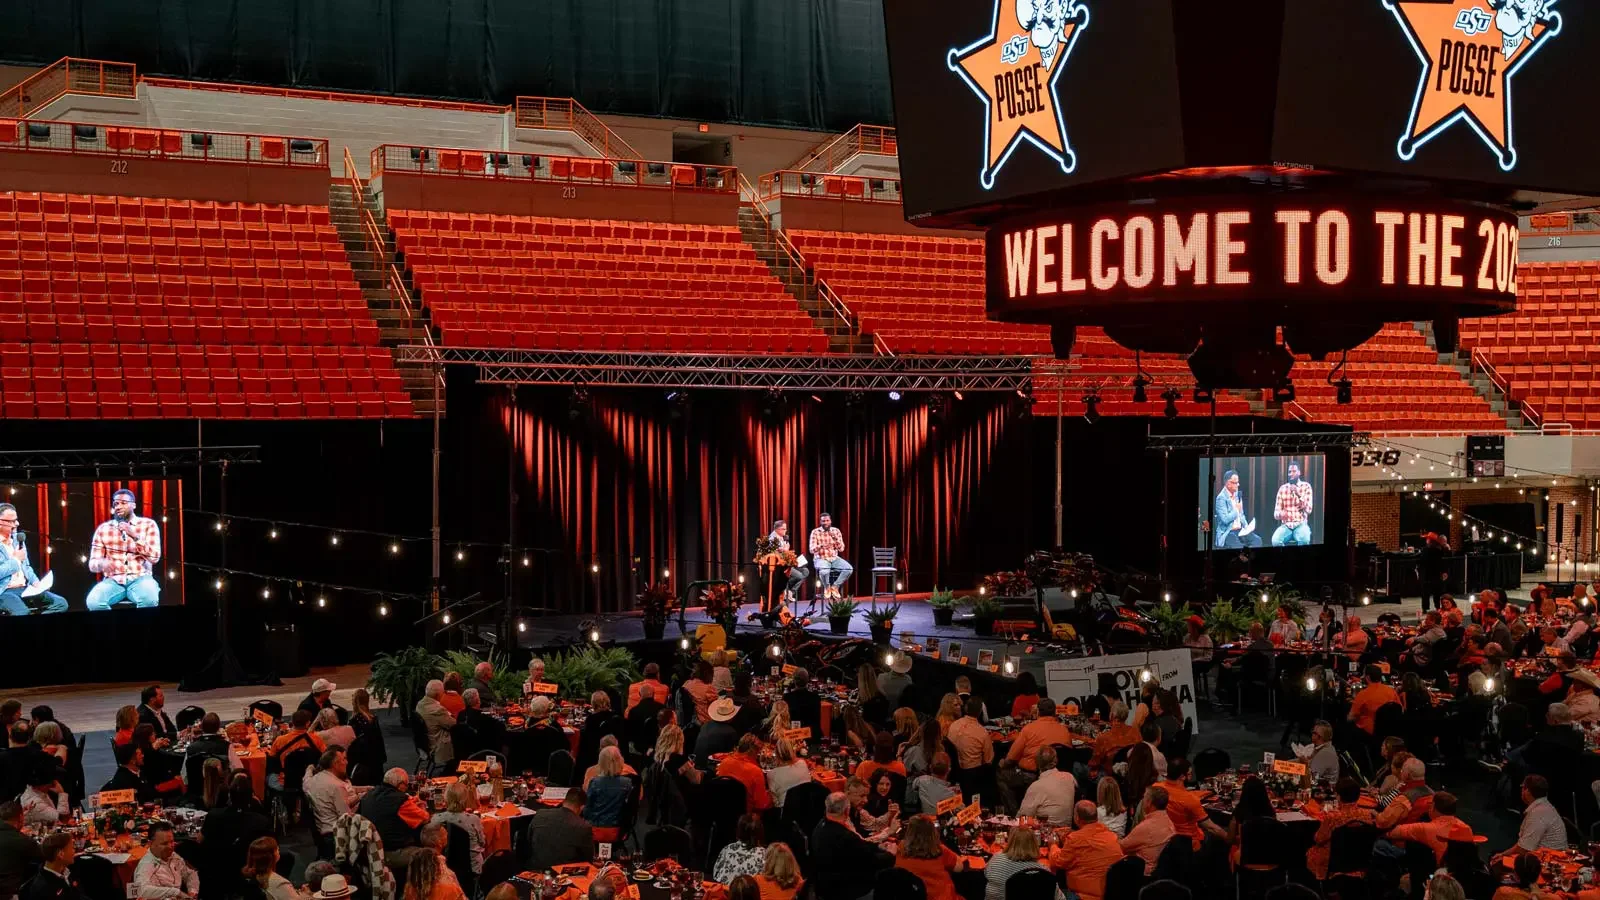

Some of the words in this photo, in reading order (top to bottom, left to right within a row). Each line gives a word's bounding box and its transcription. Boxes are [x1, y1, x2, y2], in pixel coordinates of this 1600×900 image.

[1455, 7, 1493, 35] OSU
[1001, 35, 1029, 63] OSU
[1436, 38, 1500, 98] POSSE
[994, 62, 1045, 122] POSSE
[111, 160, 128, 173] 212
[562, 186, 576, 198] 213
[1548, 236, 1561, 246] 216
[1004, 211, 1250, 298] WELCOME
[1275, 210, 1350, 285] TO
[1375, 211, 1465, 287] THE
[1083, 664, 1096, 674] THE
[1161, 669, 1179, 682] FROM
